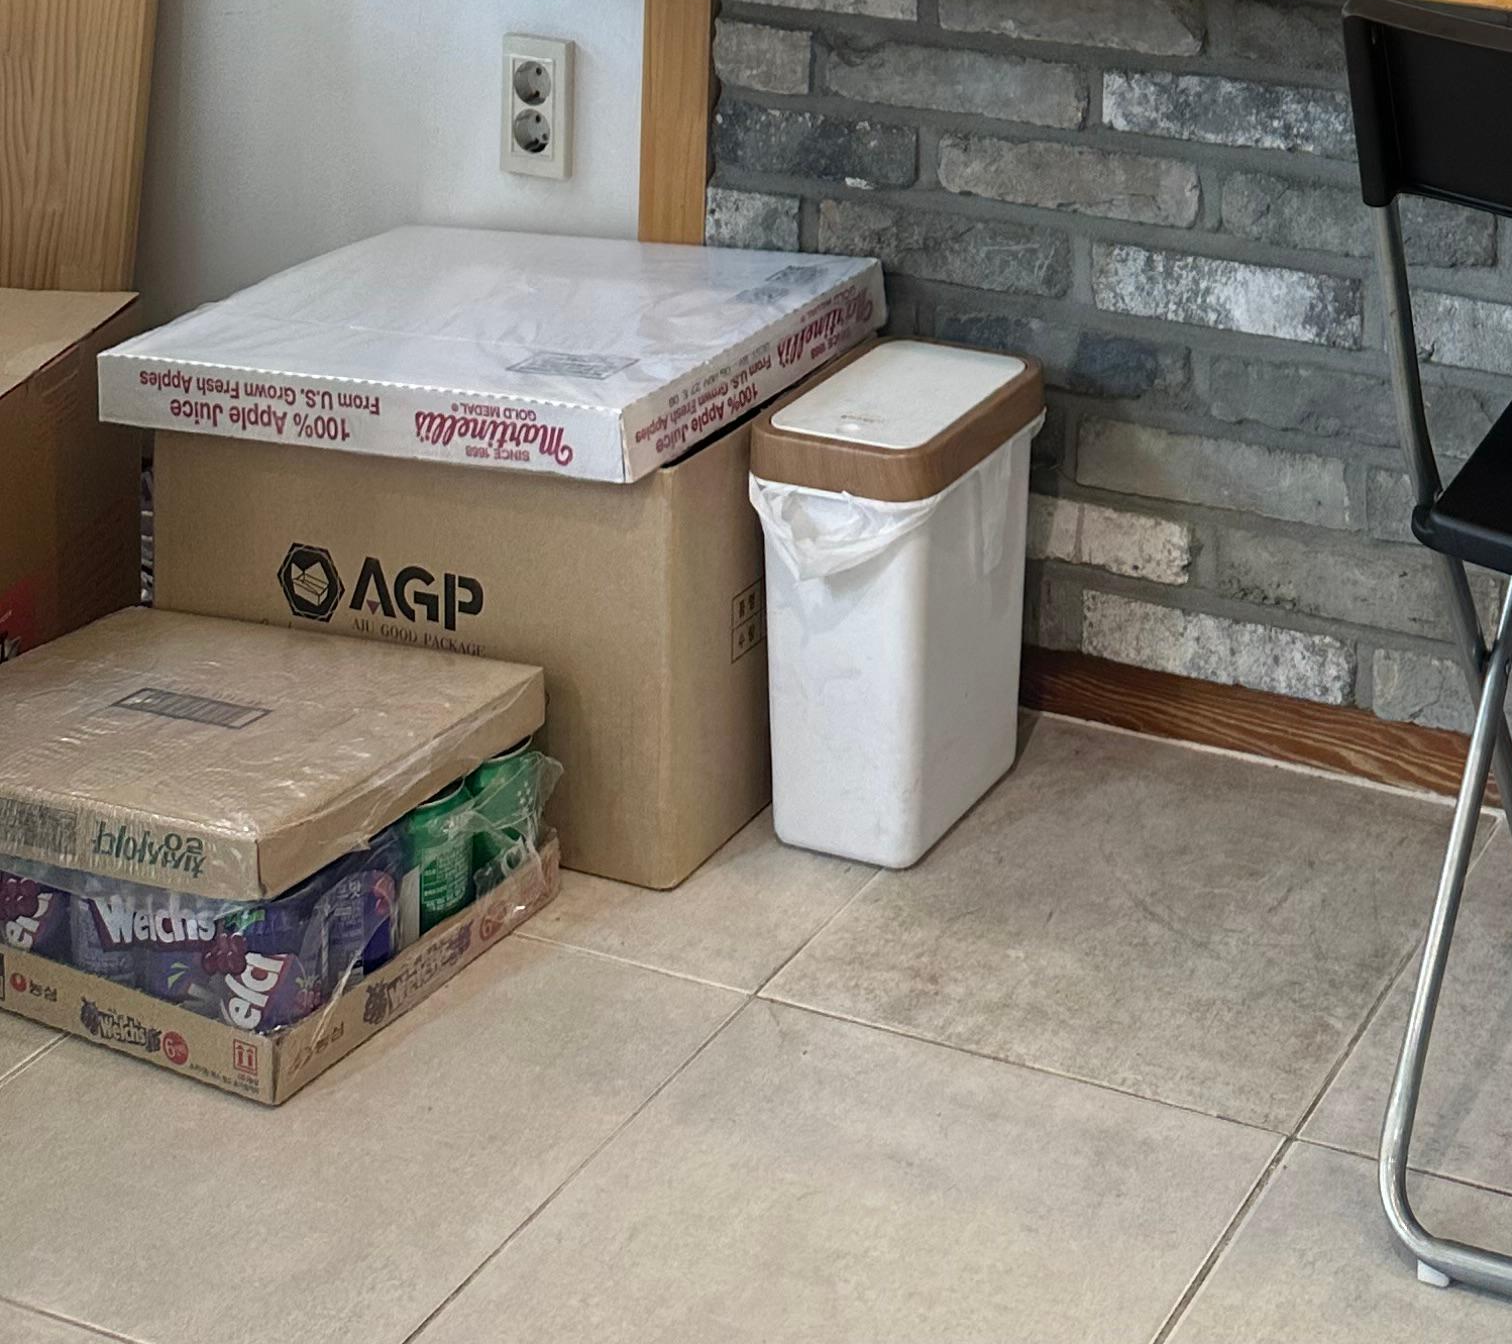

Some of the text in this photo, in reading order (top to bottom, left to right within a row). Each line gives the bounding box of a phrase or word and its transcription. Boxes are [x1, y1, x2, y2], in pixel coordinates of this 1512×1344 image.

[139, 369, 380, 415] From U.S. Grown Fresh Apples
[169, 397, 350, 442] 100% Apple Juice
[503, 406, 537, 422] GOLD
[691, 399, 725, 433] Apple
[655, 422, 687, 453] Juice
[494, 447, 531, 462] SINCE
[348, 556, 484, 631] AGP
[380, 625, 418, 643] GOOD
[423, 631, 487, 657] PACKAGE
